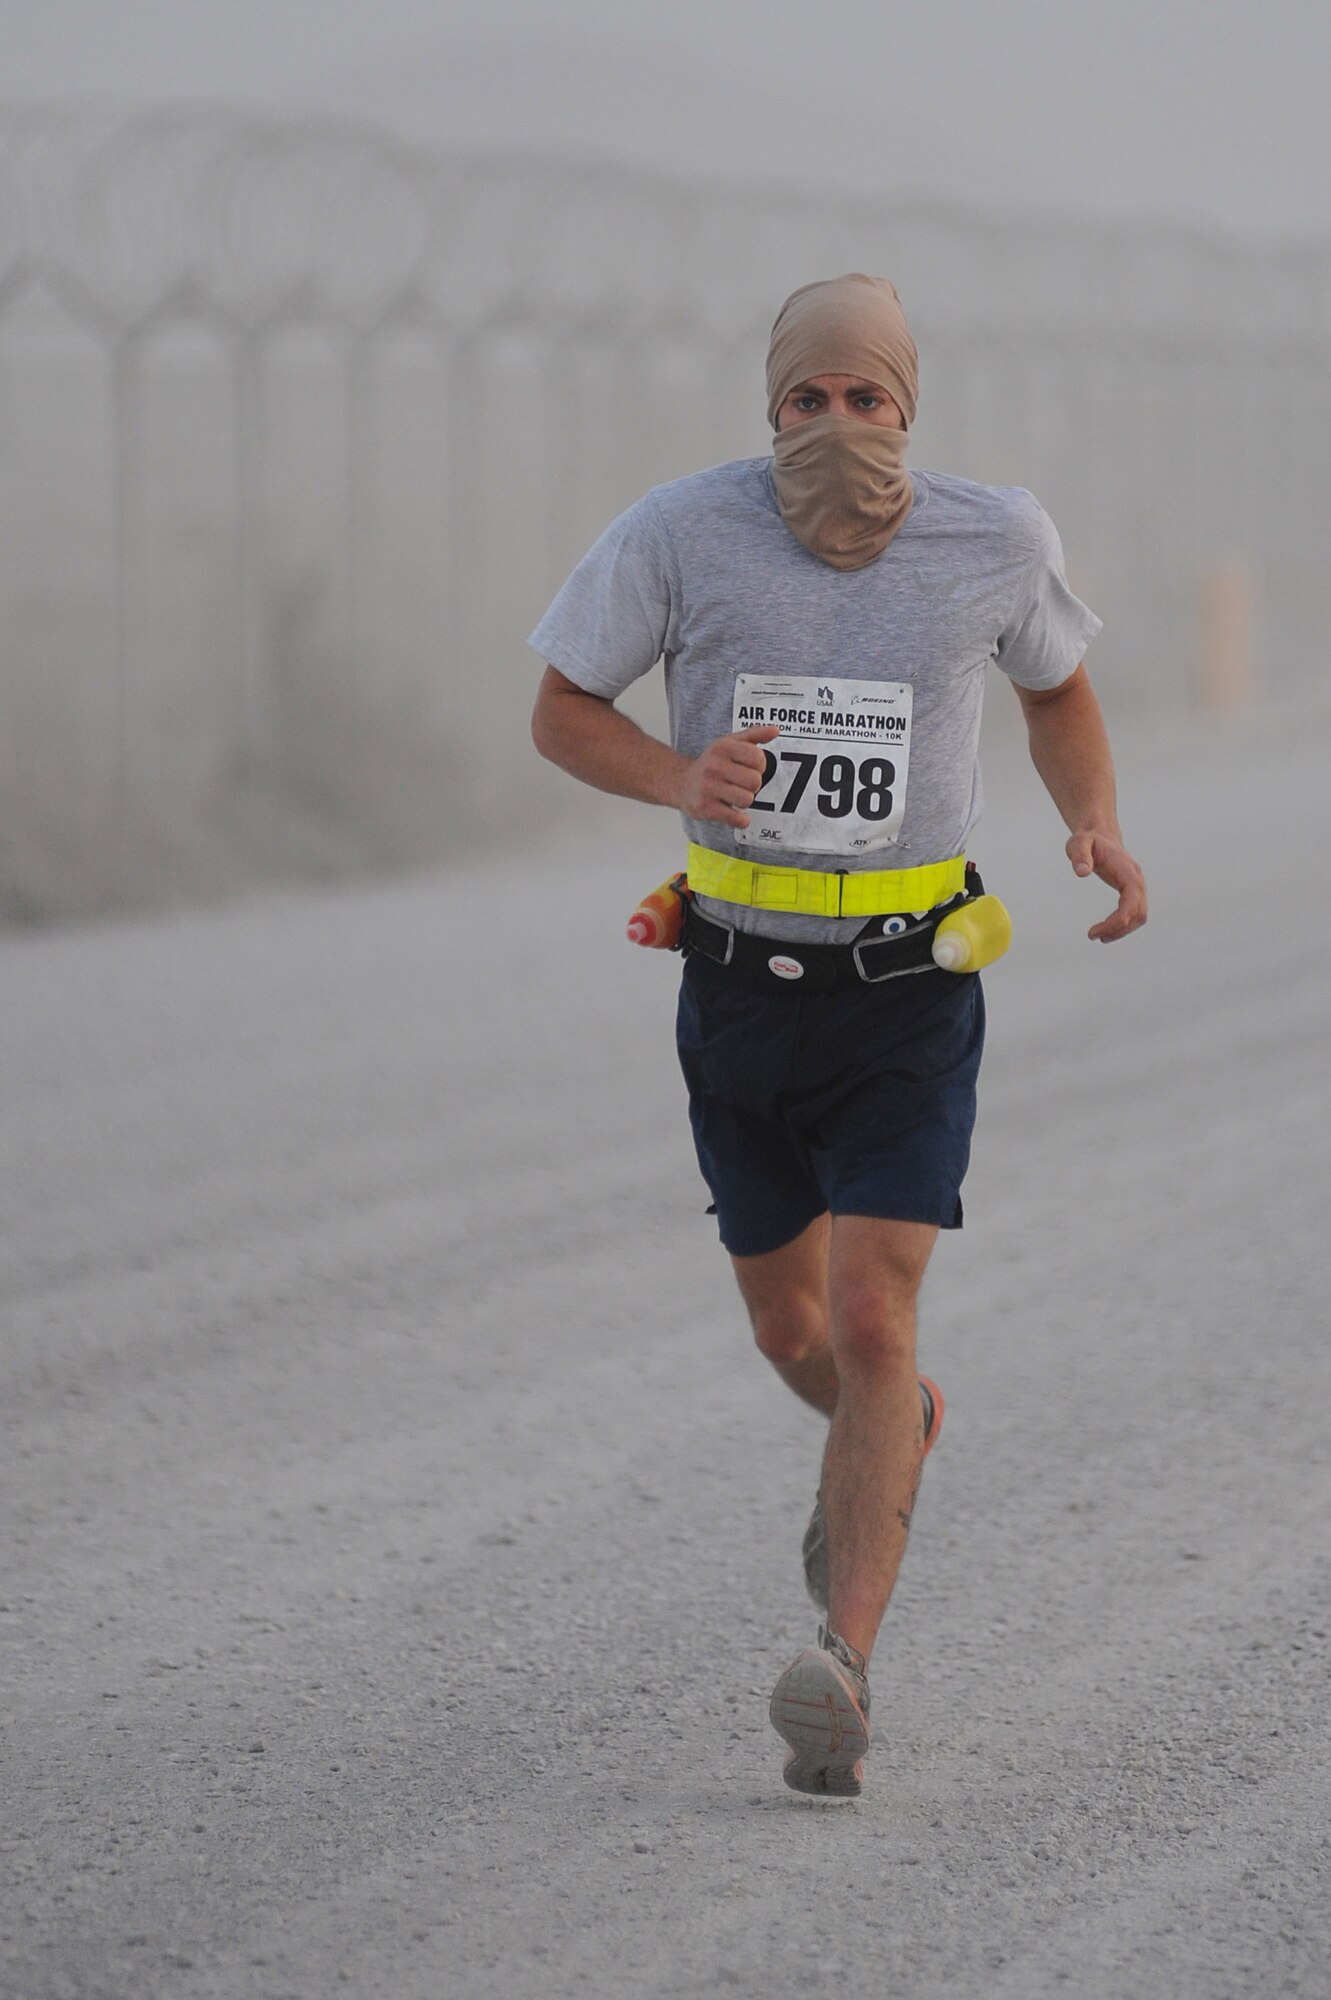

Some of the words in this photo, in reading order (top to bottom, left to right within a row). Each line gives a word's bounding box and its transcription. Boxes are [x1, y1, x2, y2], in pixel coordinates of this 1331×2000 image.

[861, 697, 896, 705] BOEING
[738, 706, 765, 720] AIR
[769, 708, 816, 724] FORCE
[820, 712, 906, 731] MARATHON
[741, 721, 792, 732] MARON
[825, 728, 877, 739] MARATHON
[885, 732, 903, 740] 10K
[749, 748, 896, 821] 2798
